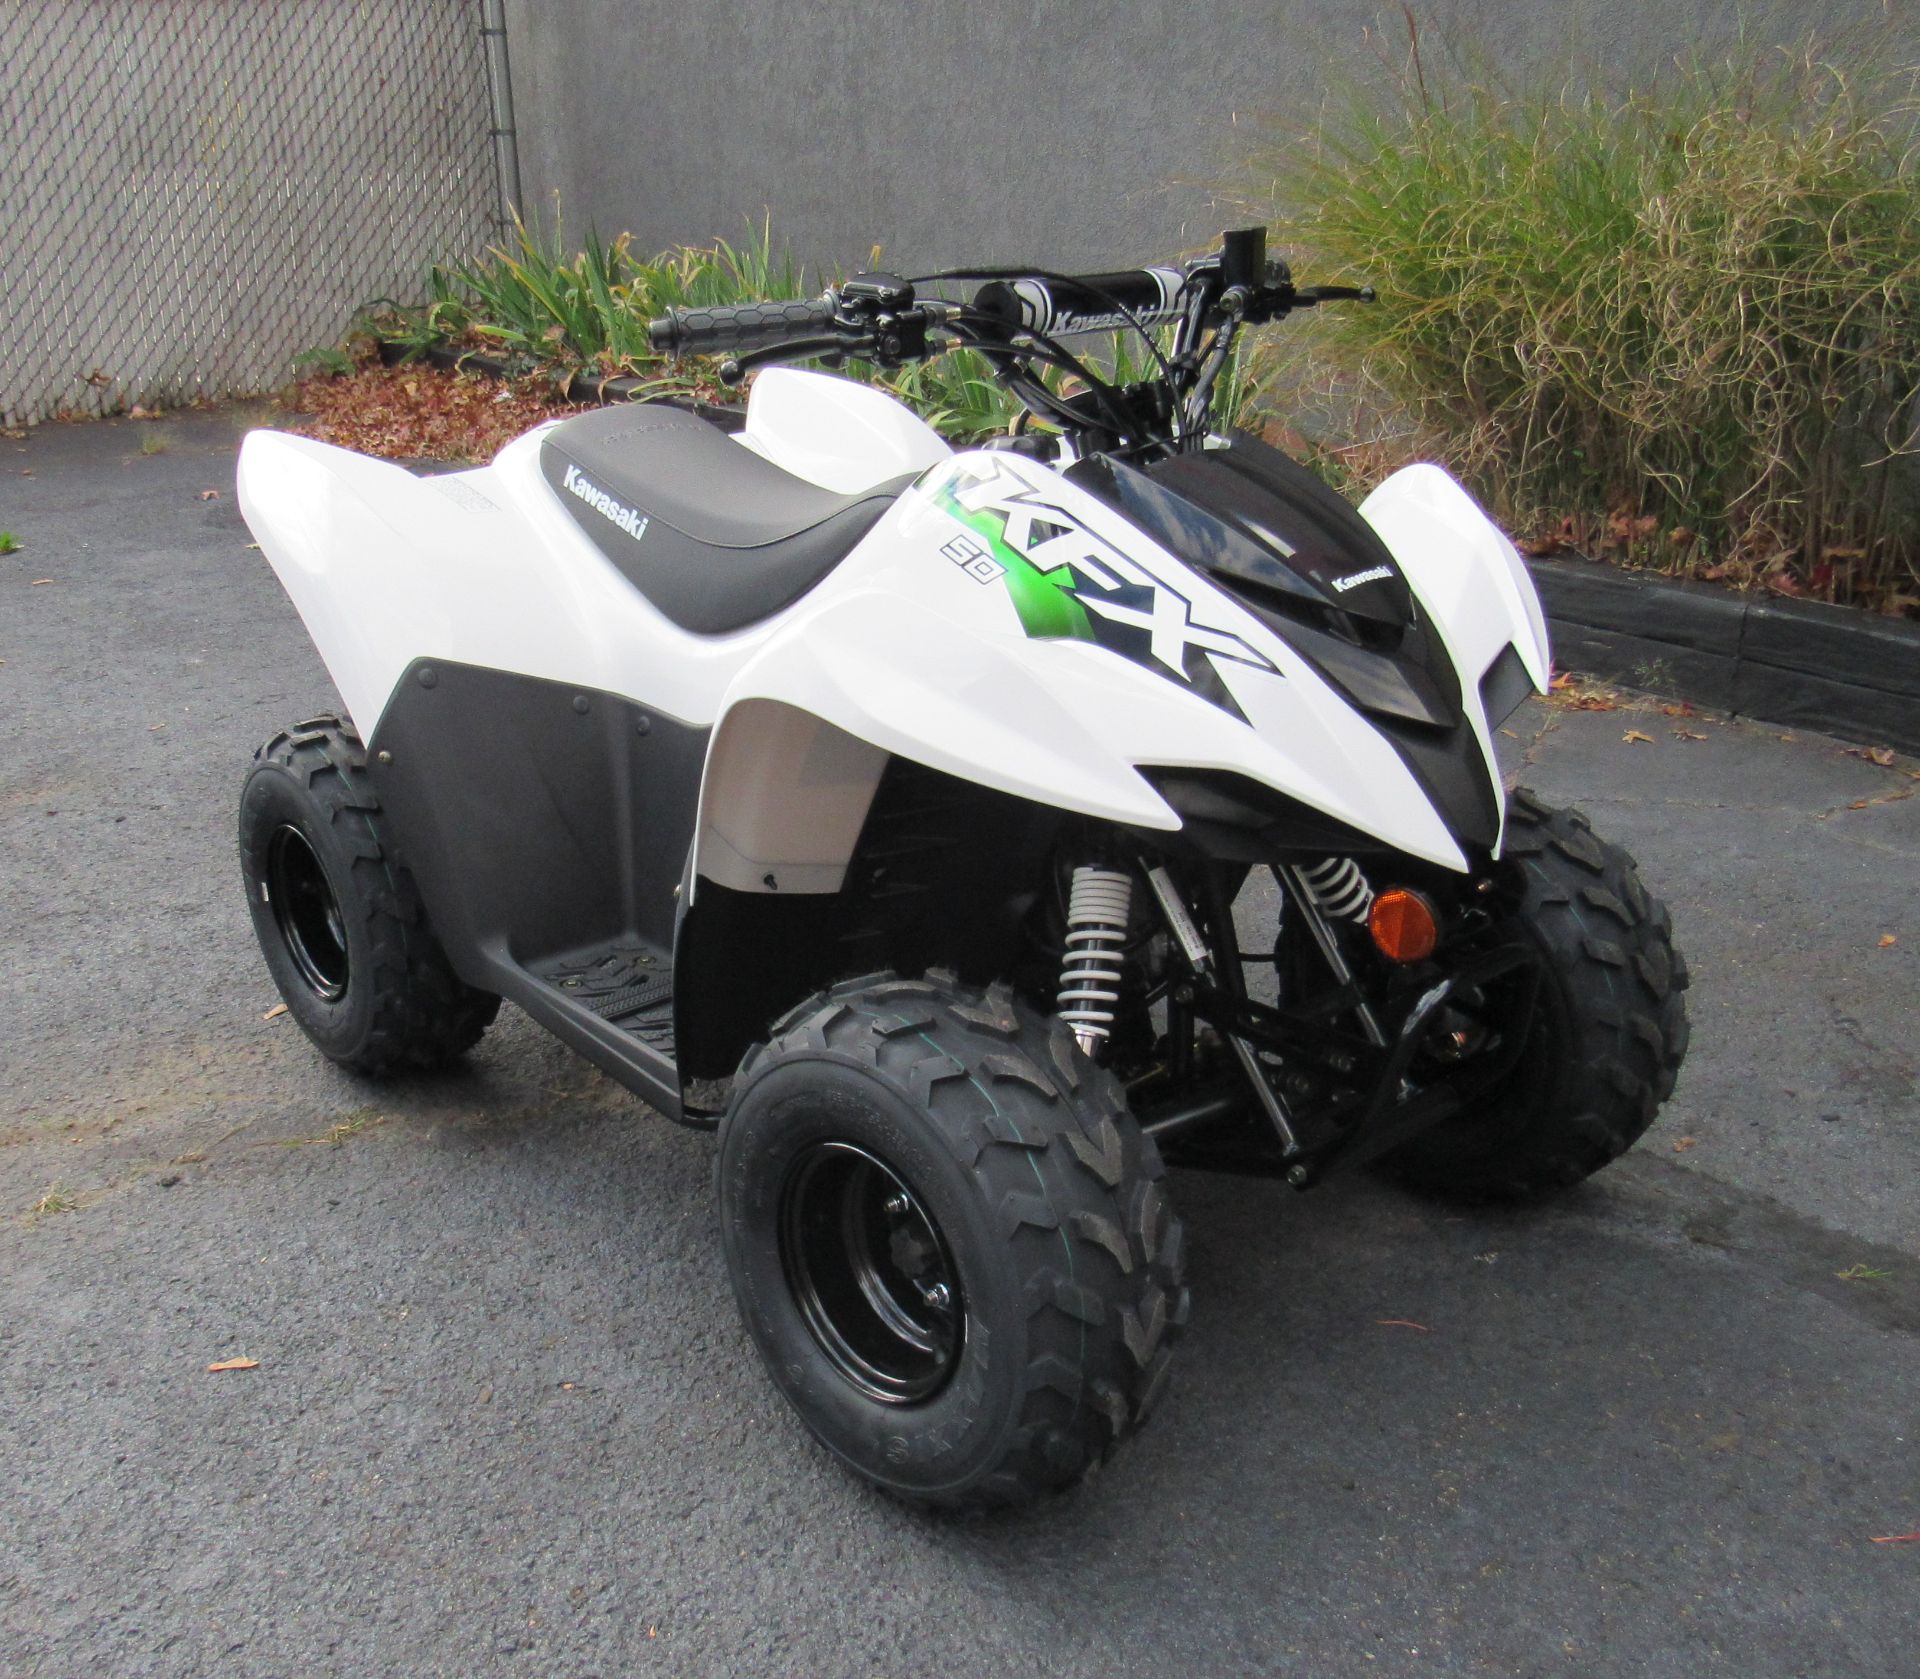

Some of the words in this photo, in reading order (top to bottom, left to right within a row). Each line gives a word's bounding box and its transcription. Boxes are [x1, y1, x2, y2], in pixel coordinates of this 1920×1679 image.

[562, 463, 650, 542] Kawasaki
[938, 533, 1010, 586] 50
[952, 456, 1287, 685] KFX
[1330, 565, 1394, 593] Kawasaki
